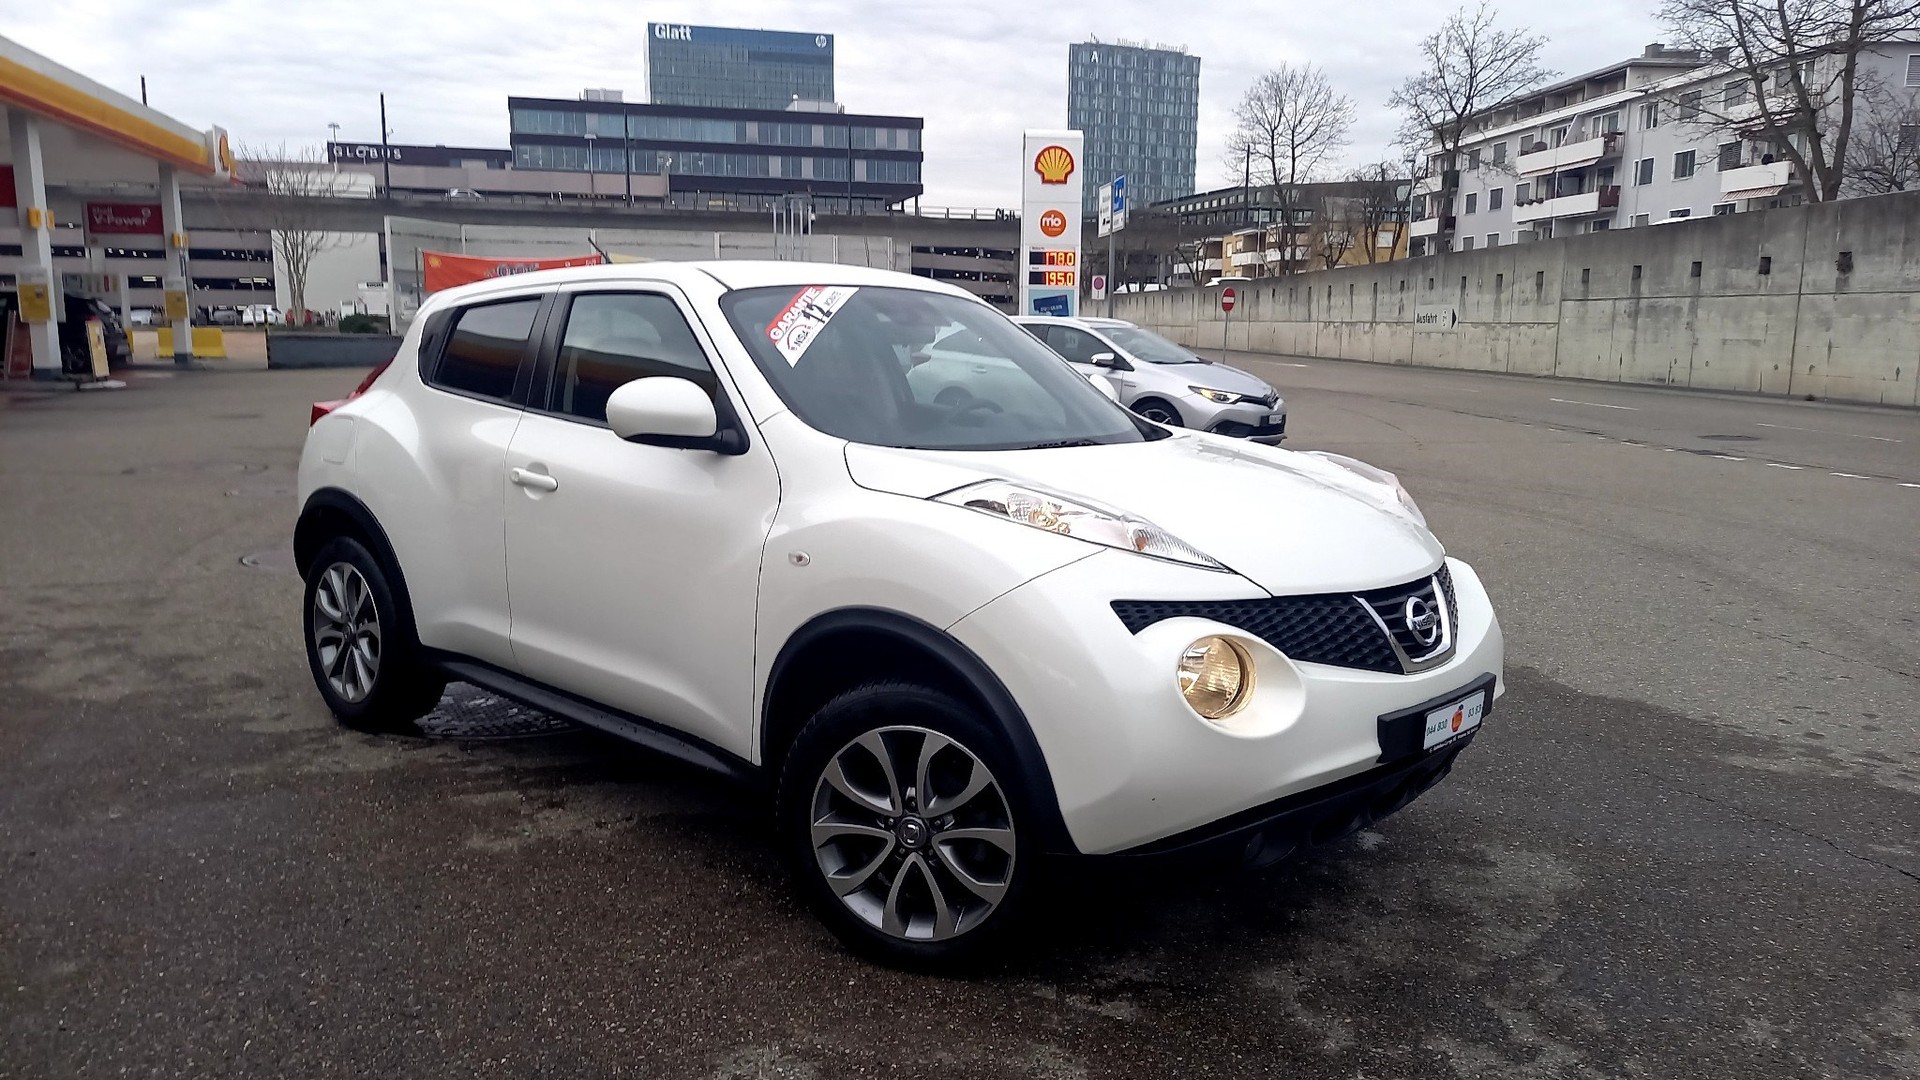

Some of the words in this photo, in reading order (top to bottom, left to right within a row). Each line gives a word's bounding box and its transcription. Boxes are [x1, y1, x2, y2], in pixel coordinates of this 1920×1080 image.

[655, 23, 692, 41] Glatt
[333, 145, 402, 160] GLOBUS
[1042, 214, 1062, 227] mio
[769, 286, 821, 340] GARANTIE
[801, 303, 833, 324] 12
[1416, 312, 1438, 324] Ausfahrt
